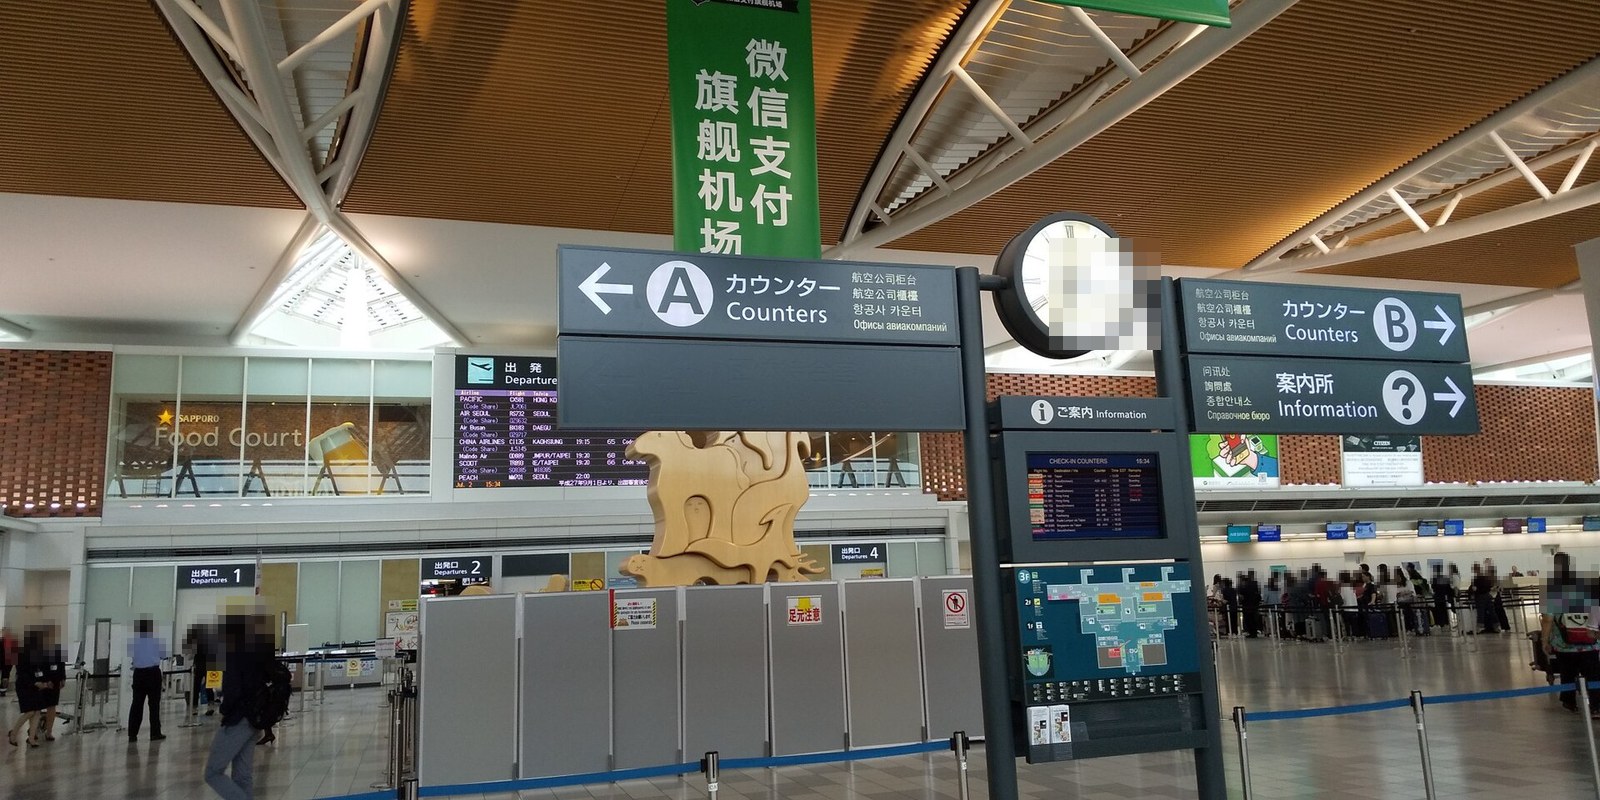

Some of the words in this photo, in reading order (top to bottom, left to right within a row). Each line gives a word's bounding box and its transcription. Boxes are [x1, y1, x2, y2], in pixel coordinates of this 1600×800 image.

[745, 38, 793, 227] 微信支付
[694, 69, 743, 255] 旗舰机场
[726, 273, 841, 297] カウンター
[851, 272, 917, 286] 航空公司柜台
[657, 266, 705, 315] A
[1195, 288, 1250, 301] 航空公司柜台
[726, 302, 828, 324] Counters
[853, 303, 887, 316] 항공사
[890, 305, 922, 318] 카운터
[1282, 300, 1366, 320] カウンター
[853, 319, 885, 332] Офисы
[886, 322, 948, 333] авиакомпаний
[1198, 317, 1226, 329] 항공사
[1228, 318, 1256, 330] 카운터
[1384, 304, 1410, 343] B
[1199, 331, 1225, 343] Офисы
[1226, 333, 1278, 344] авиакомпаний
[1285, 323, 1359, 343] Counters
[504, 362, 542, 374] 出発
[1202, 366, 1231, 377] 问讯处
[1275, 372, 1334, 395] 案内所
[1206, 395, 1253, 407] 종합안내소
[1057, 405, 1094, 419] ご案内
[1096, 409, 1147, 419] Information
[1278, 399, 1378, 418] Information
[178, 414, 220, 423] SAPPORO
[1207, 410, 1251, 422] Справочное
[1251, 410, 1271, 422] бюро
[155, 426, 219, 447] Food
[228, 427, 302, 447] Court
[1049, 457, 1076, 465] CHECK-IN
[1076, 457, 1108, 465] COUNTERS
[870, 546, 879, 558] 4
[434, 561, 459, 569] 出発口
[471, 560, 481, 574] 2
[190, 569, 218, 578] 出発口
[233, 568, 241, 583] 1
[1020, 572, 1030, 581] 3F
[190, 577, 228, 585] Departures
[788, 608, 821, 623] 足元注意
